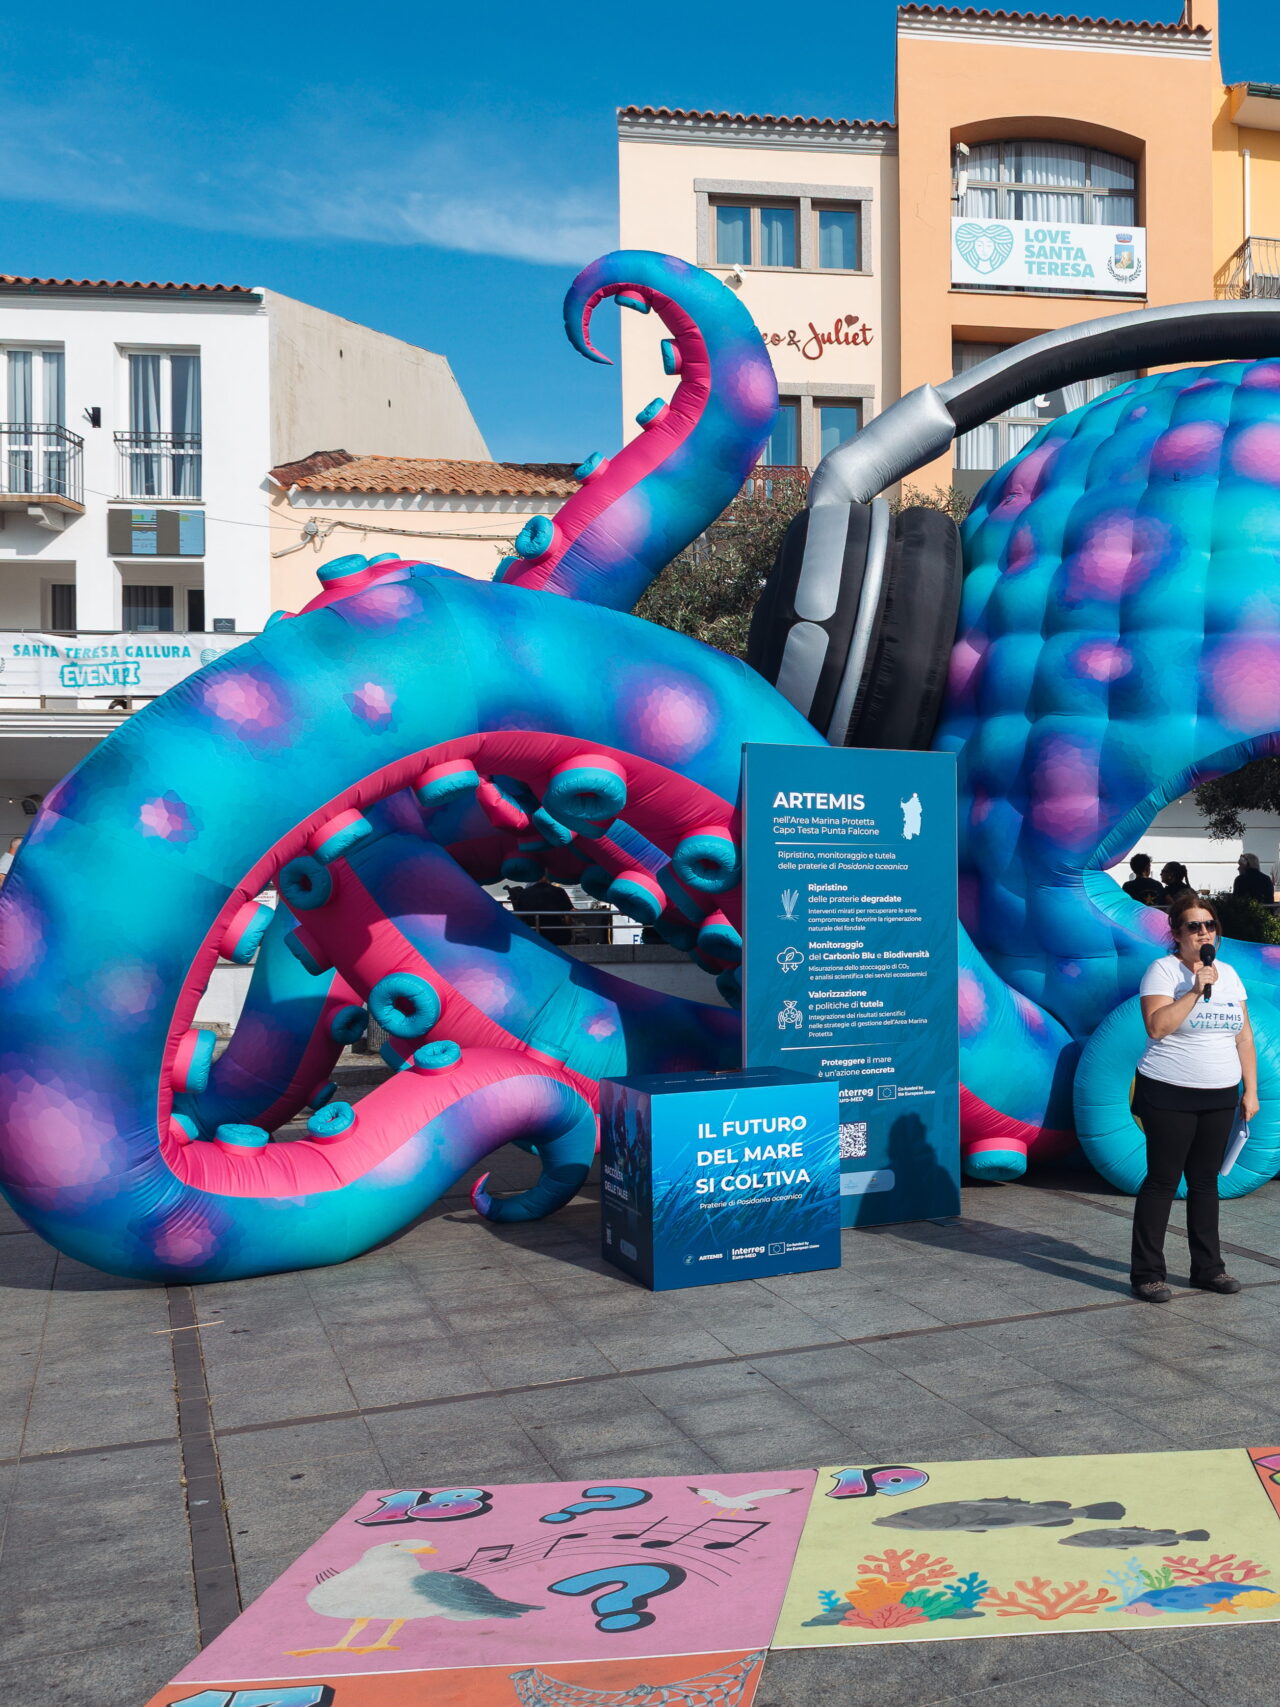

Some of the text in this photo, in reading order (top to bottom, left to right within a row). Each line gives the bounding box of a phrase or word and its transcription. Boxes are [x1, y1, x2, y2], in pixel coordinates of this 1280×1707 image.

[1024, 228, 1071, 244] LOVE
[1024, 244, 1087, 262] SANTA
[1024, 260, 1096, 279] TERESA
[786, 329, 801, 352] &
[802, 317, 874, 360] Juliet
[12, 644, 191, 659] SANTA TERESA GALLURA
[60, 662, 140, 687] EVENTI
[773, 791, 866, 811] ARTEMIS
[773, 816, 875, 826] nell'Area Marina Protetta
[773, 826, 880, 836] Capo Testa Punta Falcone
[777, 851, 816, 860] Ripristino,
[817, 852, 868, 861] monitoraggio
[874, 851, 896, 860] tutela
[777, 862, 797, 870] delle
[798, 862, 828, 871] praterie
[829, 862, 837, 870] di
[807, 883, 848, 892] Ripristino
[807, 895, 902, 904] delle praterie degradate
[844, 923, 866, 931] fondale
[808, 941, 864, 950] Monitoraggio
[822, 952, 860, 960] Carbonio
[883, 950, 930, 959] Biodiversità
[859, 963, 891, 971] stoccaggio
[808, 989, 867, 999] Valorizzazione
[815, 1002, 849, 1011] politiche
[850, 1001, 859, 1009] di
[860, 1000, 884, 1009] tutela
[879, 1010, 906, 1018] scientifici
[1196, 1013, 1241, 1021] ARTEMIS
[821, 1058, 866, 1067] Proteggere
[866, 1056, 872, 1064] il
[824, 1068, 861, 1077] un'azione
[861, 1066, 895, 1075] concreta
[838, 1087, 874, 1097] nterreg
[698, 1115, 807, 1139] IL FUTURO
[697, 1142, 804, 1167] DEL MARE
[695, 1168, 811, 1194] SI COLTIVA
[700, 1200, 728, 1209] Praterie
[736, 1195, 771, 1205] Posidonia
[771, 1193, 803, 1201] oceanica
[731, 1245, 765, 1256] Interreg
[699, 1253, 724, 1261] ARTEMIS
[355, 1487, 494, 1527] 18
